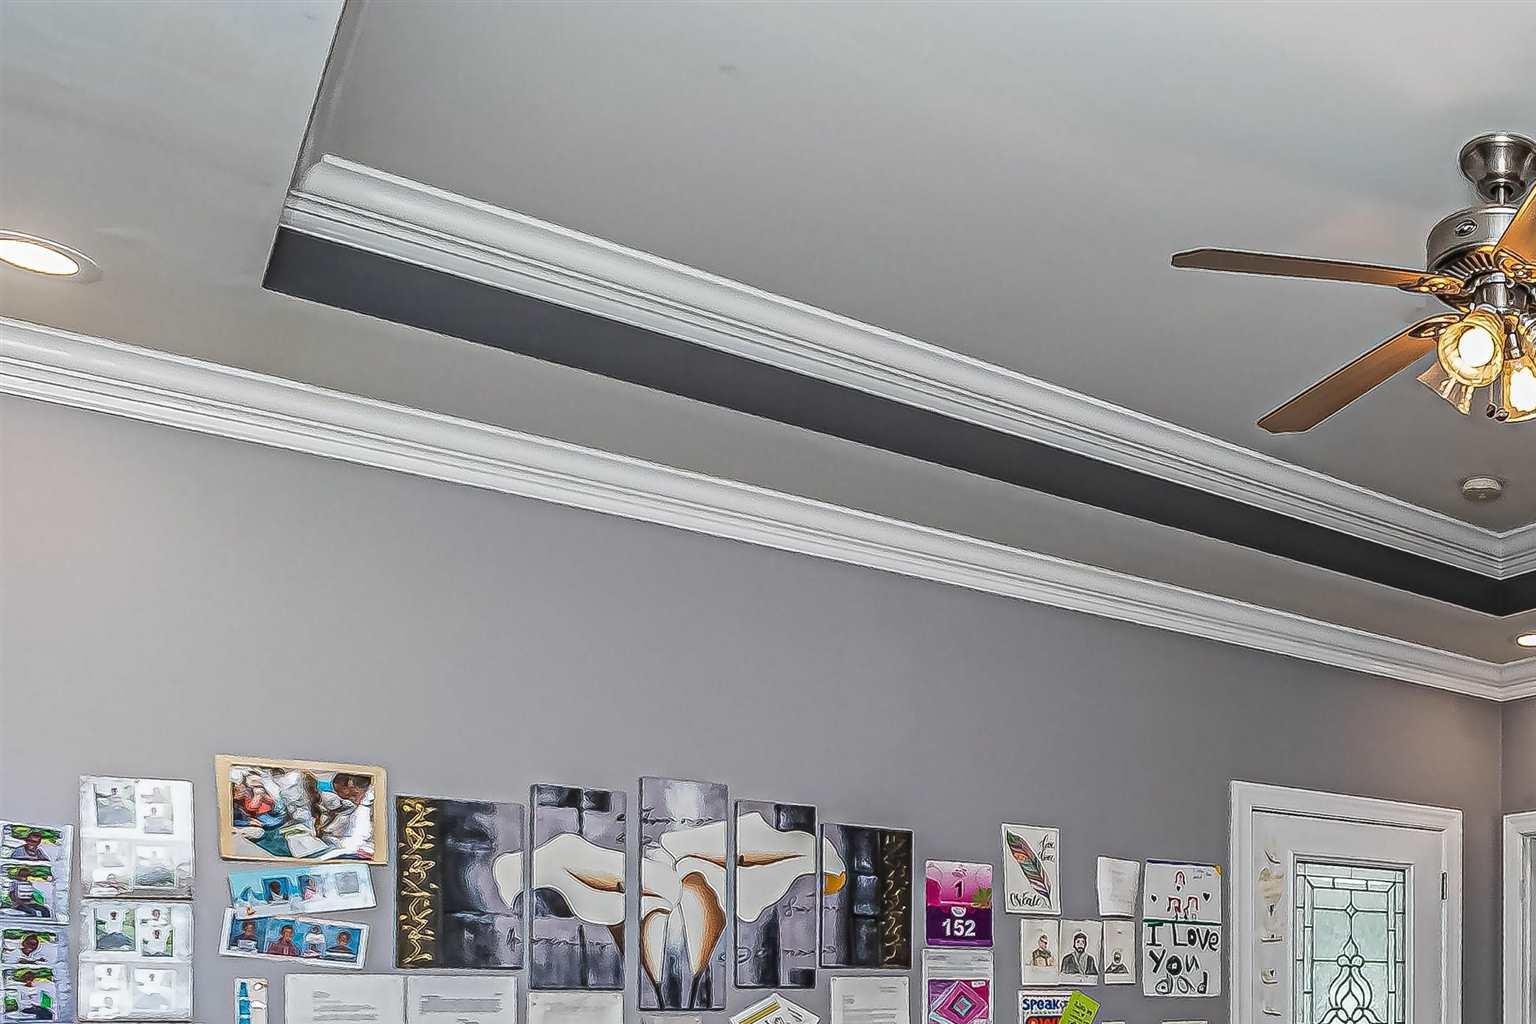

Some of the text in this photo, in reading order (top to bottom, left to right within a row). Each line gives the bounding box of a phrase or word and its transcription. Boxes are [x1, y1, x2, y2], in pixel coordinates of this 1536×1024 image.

[954, 880, 965, 899] 1
[941, 918, 977, 938] 152
[1146, 922, 1220, 952] I Love
[1155, 971, 1209, 995] dad
